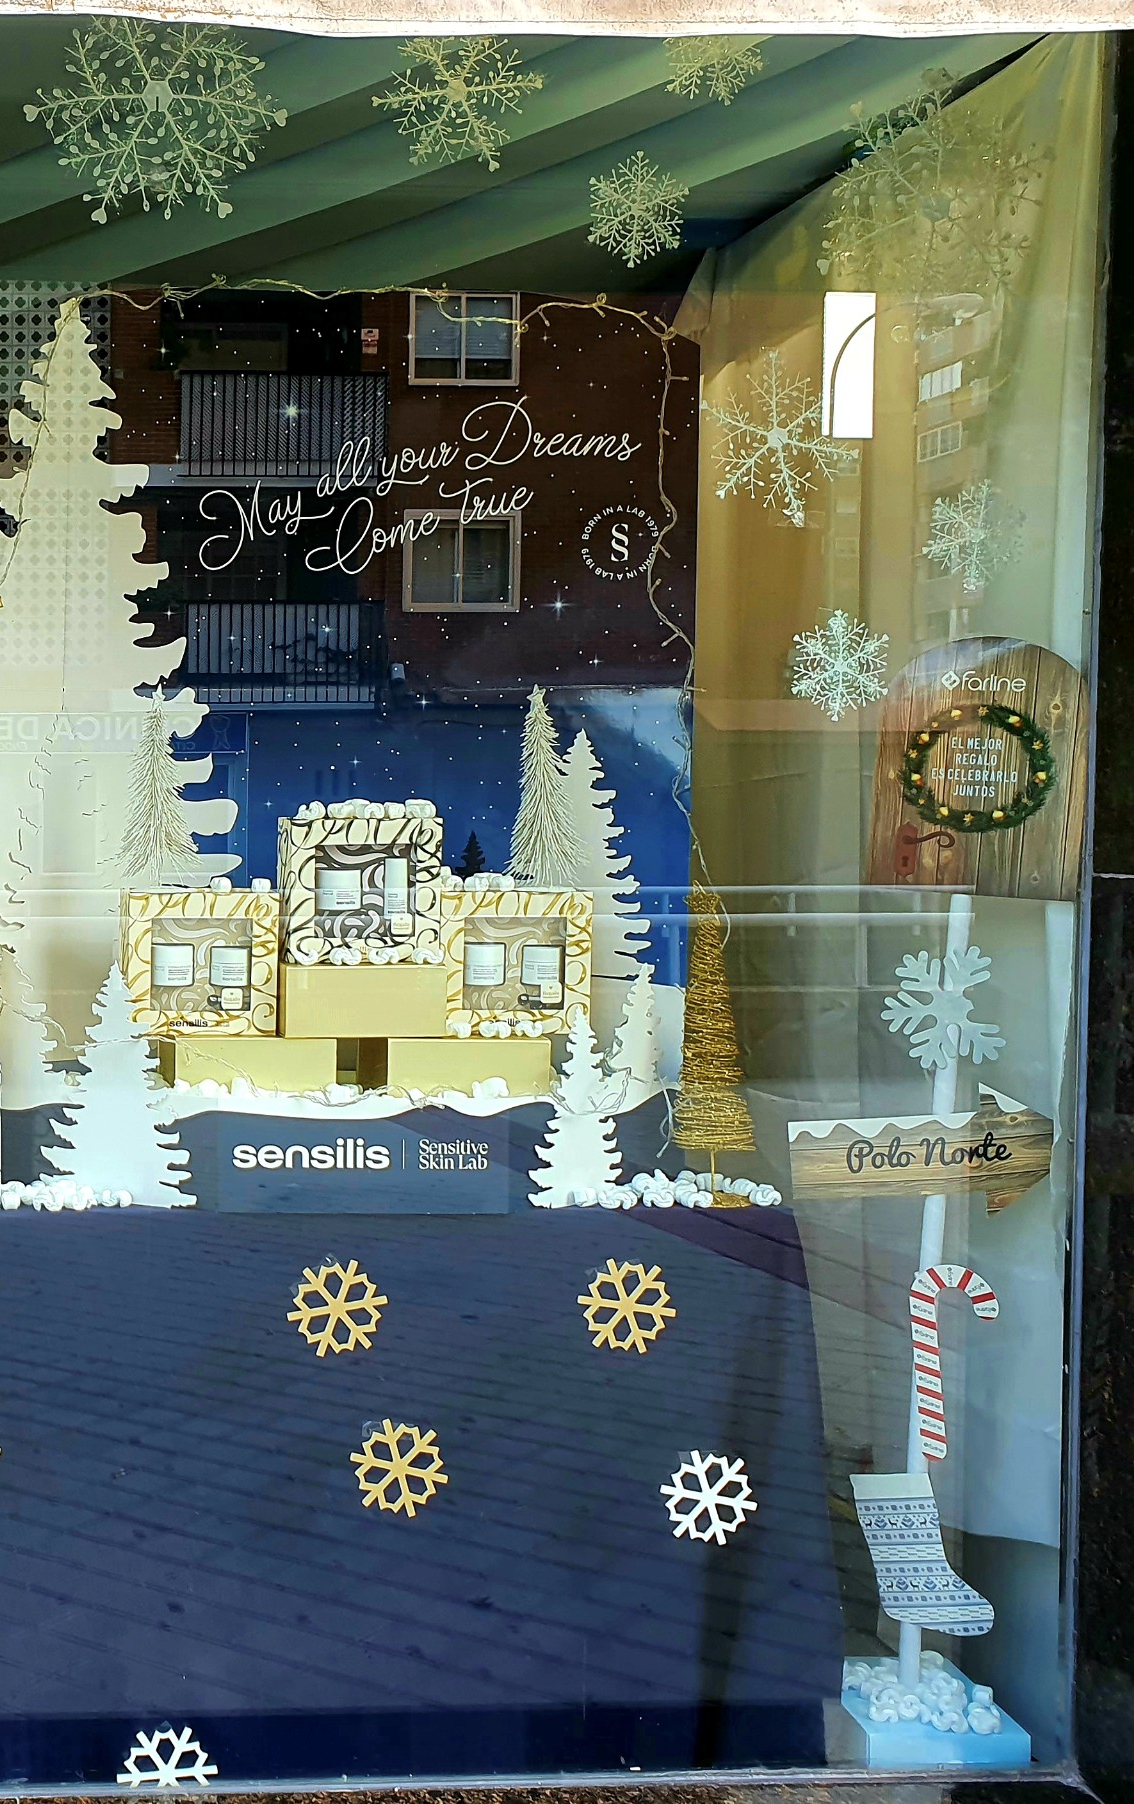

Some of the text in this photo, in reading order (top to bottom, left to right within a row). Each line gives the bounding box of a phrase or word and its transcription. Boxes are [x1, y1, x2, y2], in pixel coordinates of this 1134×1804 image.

[199, 395, 642, 570] May all your Dreams
[581, 514, 602, 540] BORN
[602, 506, 614, 516] IN
[626, 505, 646, 518] LAB
[645, 516, 659, 537] 1979
[305, 496, 441, 574] Come
[962, 670, 1027, 692] farline
[952, 738, 1002, 750] EL MEJOR
[955, 754, 998, 766] REGALO
[931, 768, 1018, 782] ES CELEBRARLO
[953, 785, 995, 797] JUNTOS
[232, 1137, 489, 1170] sensilis Sensitive
[418, 1154, 488, 1170] Skin Lab
[846, 1132, 1012, 1174] Polo Norte
